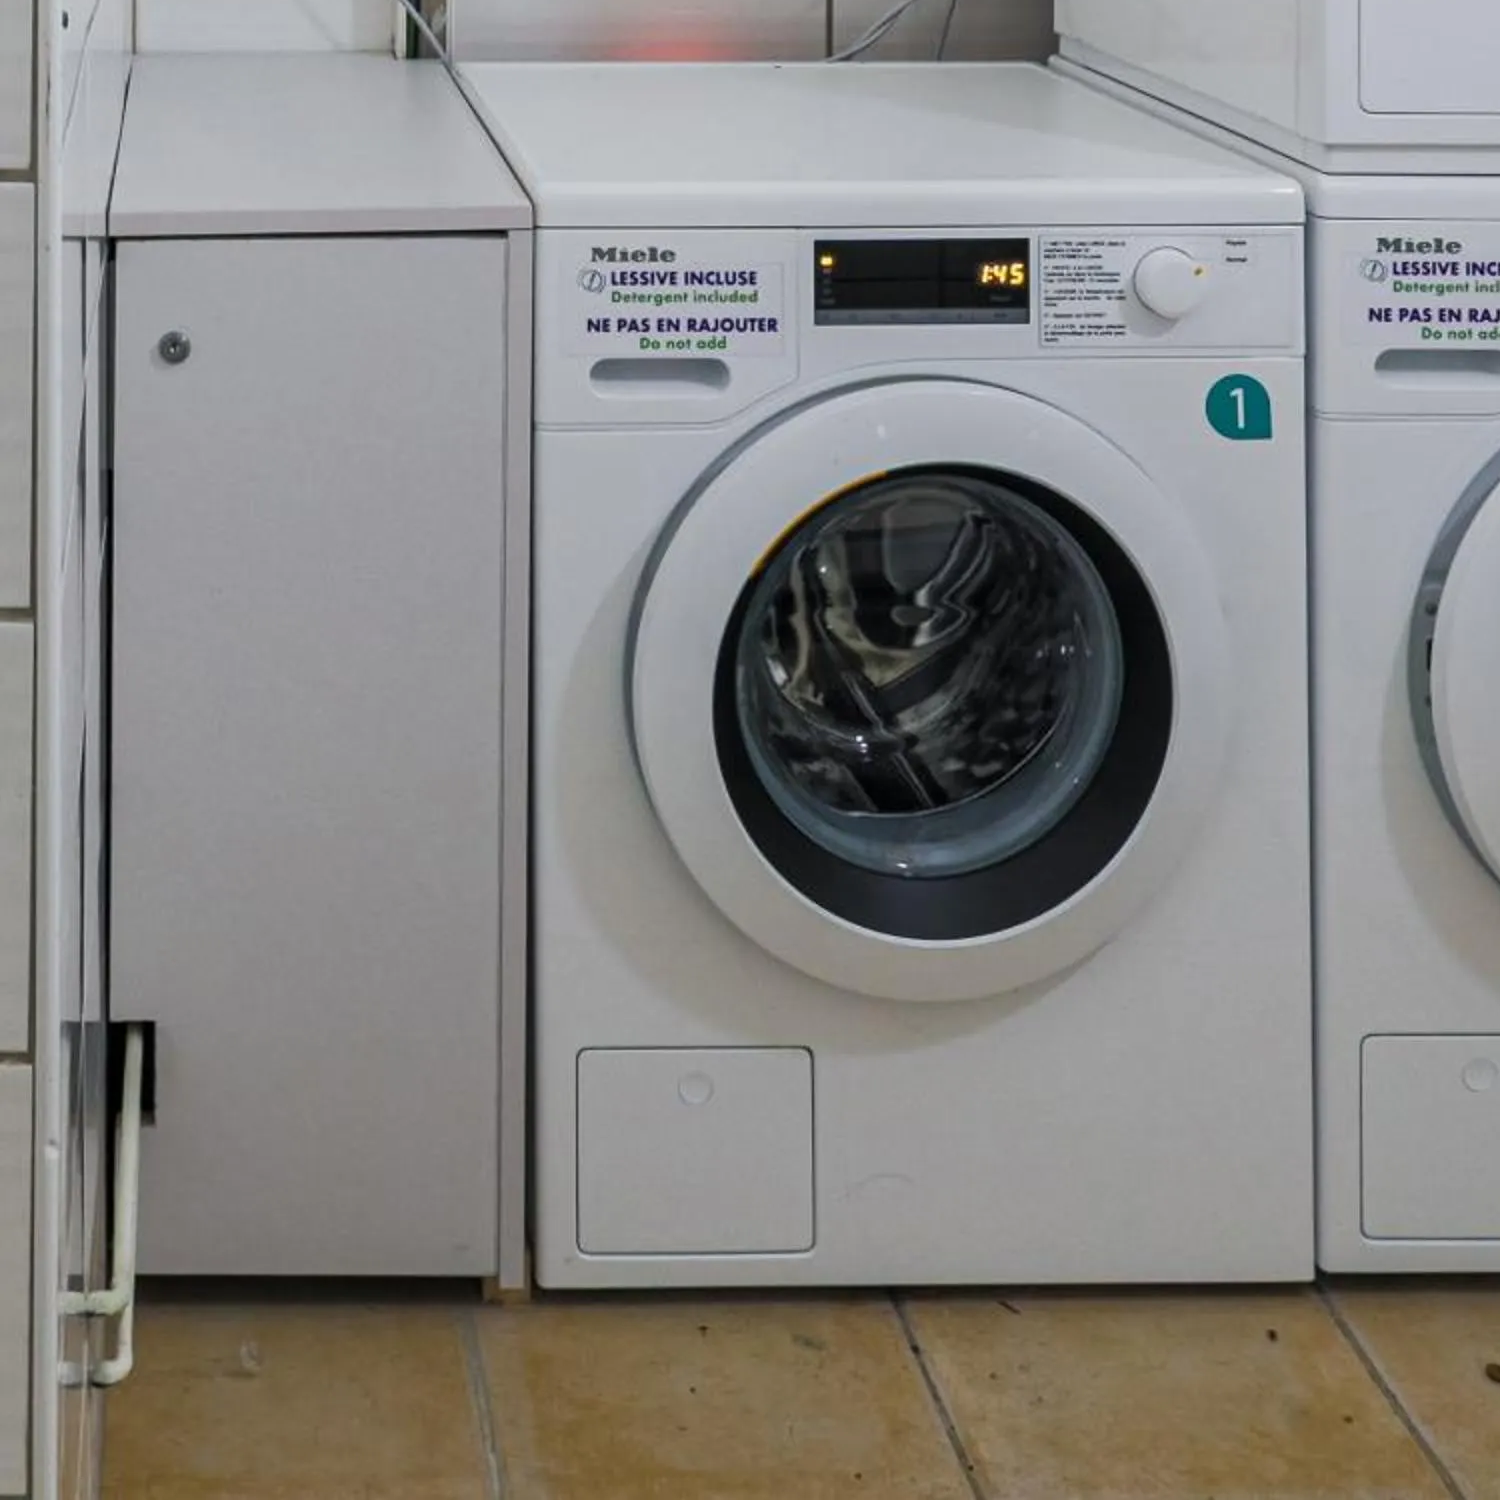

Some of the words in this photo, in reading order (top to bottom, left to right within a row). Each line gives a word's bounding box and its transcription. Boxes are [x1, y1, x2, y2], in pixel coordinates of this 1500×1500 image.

[1376, 238, 1462, 254] Miele
[591, 247, 676, 263] Miele
[981, 263, 1025, 285] 1:45
[1392, 261, 1459, 276] LESSIVE
[611, 271, 678, 285] LESSIVE
[684, 271, 758, 285] INCLUSE
[1393, 280, 1469, 296] Detergent
[611, 290, 688, 306] Detergent
[693, 290, 759, 303] included
[1368, 308, 1392, 322] NE
[1399, 308, 1431, 322] PAS
[1438, 308, 1461, 322] EN
[587, 318, 610, 332] NE
[617, 318, 650, 332] PAS
[657, 318, 680, 332] EN
[687, 318, 778, 332] RAJOUTER
[1421, 327, 1442, 340] Do
[1447, 327, 1473, 340] not
[639, 337, 660, 349] Do
[665, 337, 691, 349] not
[696, 337, 727, 349] add
[1229, 387, 1245, 429] 1
